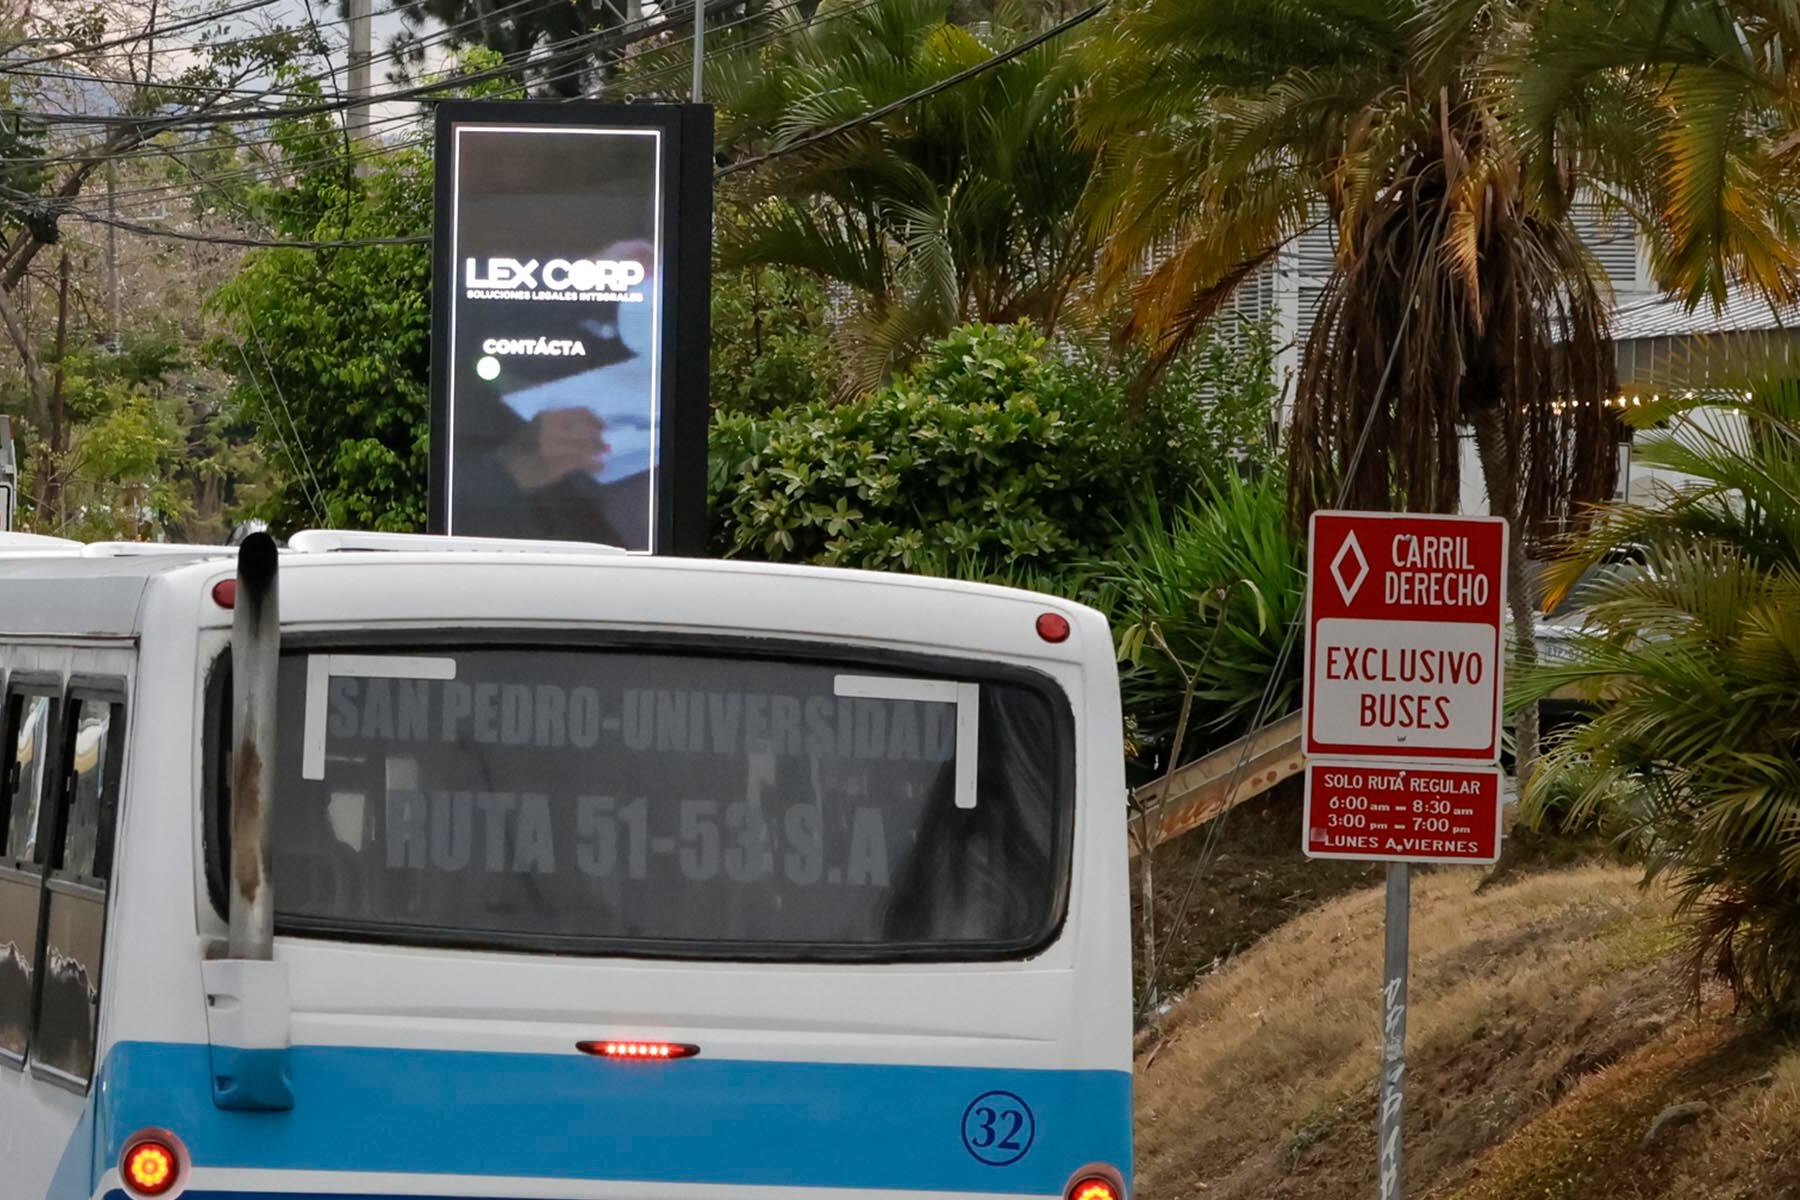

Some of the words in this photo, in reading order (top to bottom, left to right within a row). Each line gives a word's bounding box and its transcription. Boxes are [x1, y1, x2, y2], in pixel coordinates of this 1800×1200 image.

[466, 257, 539, 289] LEX
[542, 258, 645, 291] CORP
[466, 289, 531, 300] SOLUCIONES
[532, 290, 577, 301] LEGALES
[579, 291, 643, 302] INTEGRALES
[482, 336, 586, 356] CONTÁCTA
[1392, 533, 1475, 570] CARRIL
[1385, 571, 1489, 607] DERECHO
[1326, 646, 1483, 685] EXCLUSIVO
[330, 677, 429, 740] SAN
[1360, 693, 1451, 730] BUSES
[1324, 773, 1363, 789] SOLO
[1368, 775, 1405, 791] RUTA
[1410, 778, 1481, 795] REGULAR
[1329, 796, 1368, 810] 6:00
[1370, 803, 1390, 812] am
[1412, 799, 1451, 815] 8:30
[1453, 806, 1474, 816] am
[385, 789, 556, 873] RUTA
[1328, 814, 1366, 828] 3:00
[1370, 821, 1388, 831] pm
[1412, 817, 1450, 833] 7:00
[1452, 825, 1471, 835] pm
[1324, 835, 1379, 848] LUNES
[1385, 838, 1397, 849] A
[1403, 838, 1479, 853] VIERNES
[971, 1106, 1023, 1152] 32
